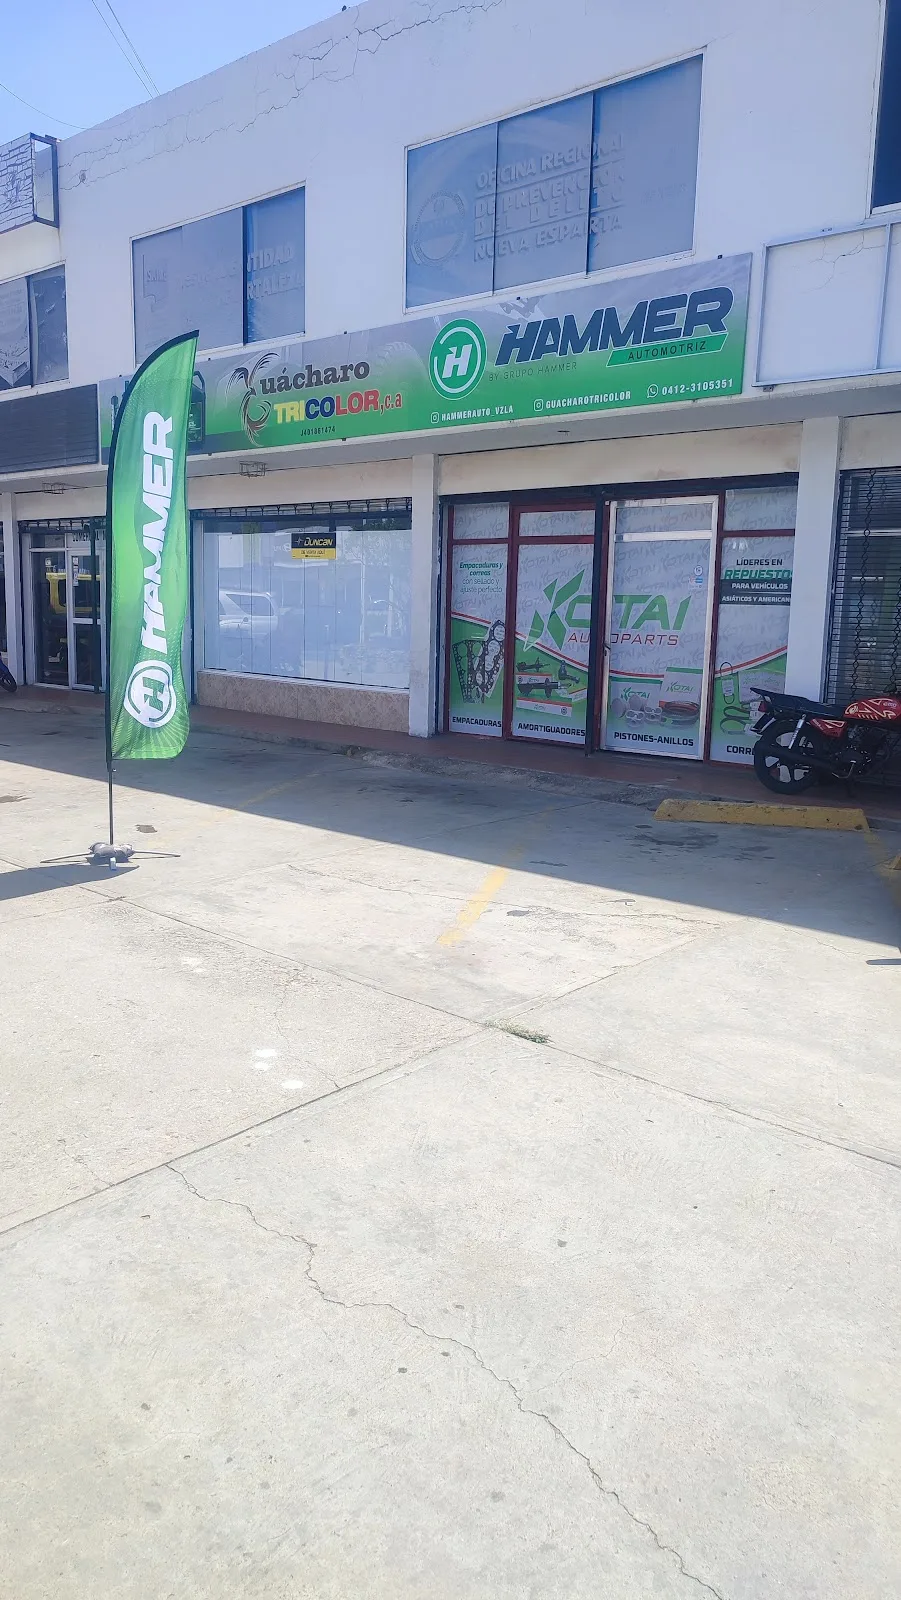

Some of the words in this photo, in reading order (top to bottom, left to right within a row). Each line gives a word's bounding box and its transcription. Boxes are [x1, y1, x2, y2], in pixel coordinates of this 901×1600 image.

[494, 286, 735, 367] HAMMER
[628, 340, 707, 361] AUTOMOTRIZ
[503, 367, 535, 380] GRUPO
[537, 361, 578, 375] HAMMER
[661, 378, 734, 397] 0412-3105351
[545, 391, 632, 410] GUACHAROTRICOLOR
[441, 405, 514, 421] HAMMERAUTO_VZLA
[140, 411, 174, 655] HAMMER
[460, 562, 499, 570] Empacaduras
[736, 557, 770, 566] LÍDERES
[771, 558, 783, 566] EN
[751, 582, 789, 590] VEHÍCULOS
[567, 632, 679, 646] AUOPARTS
[452, 716, 502, 728] EMPACADURAS
[517, 722, 586, 737] AMORTIGUADORES
[613, 731, 694, 747] PISTONES-ANILLOS
[726, 745, 755, 756] CORR
